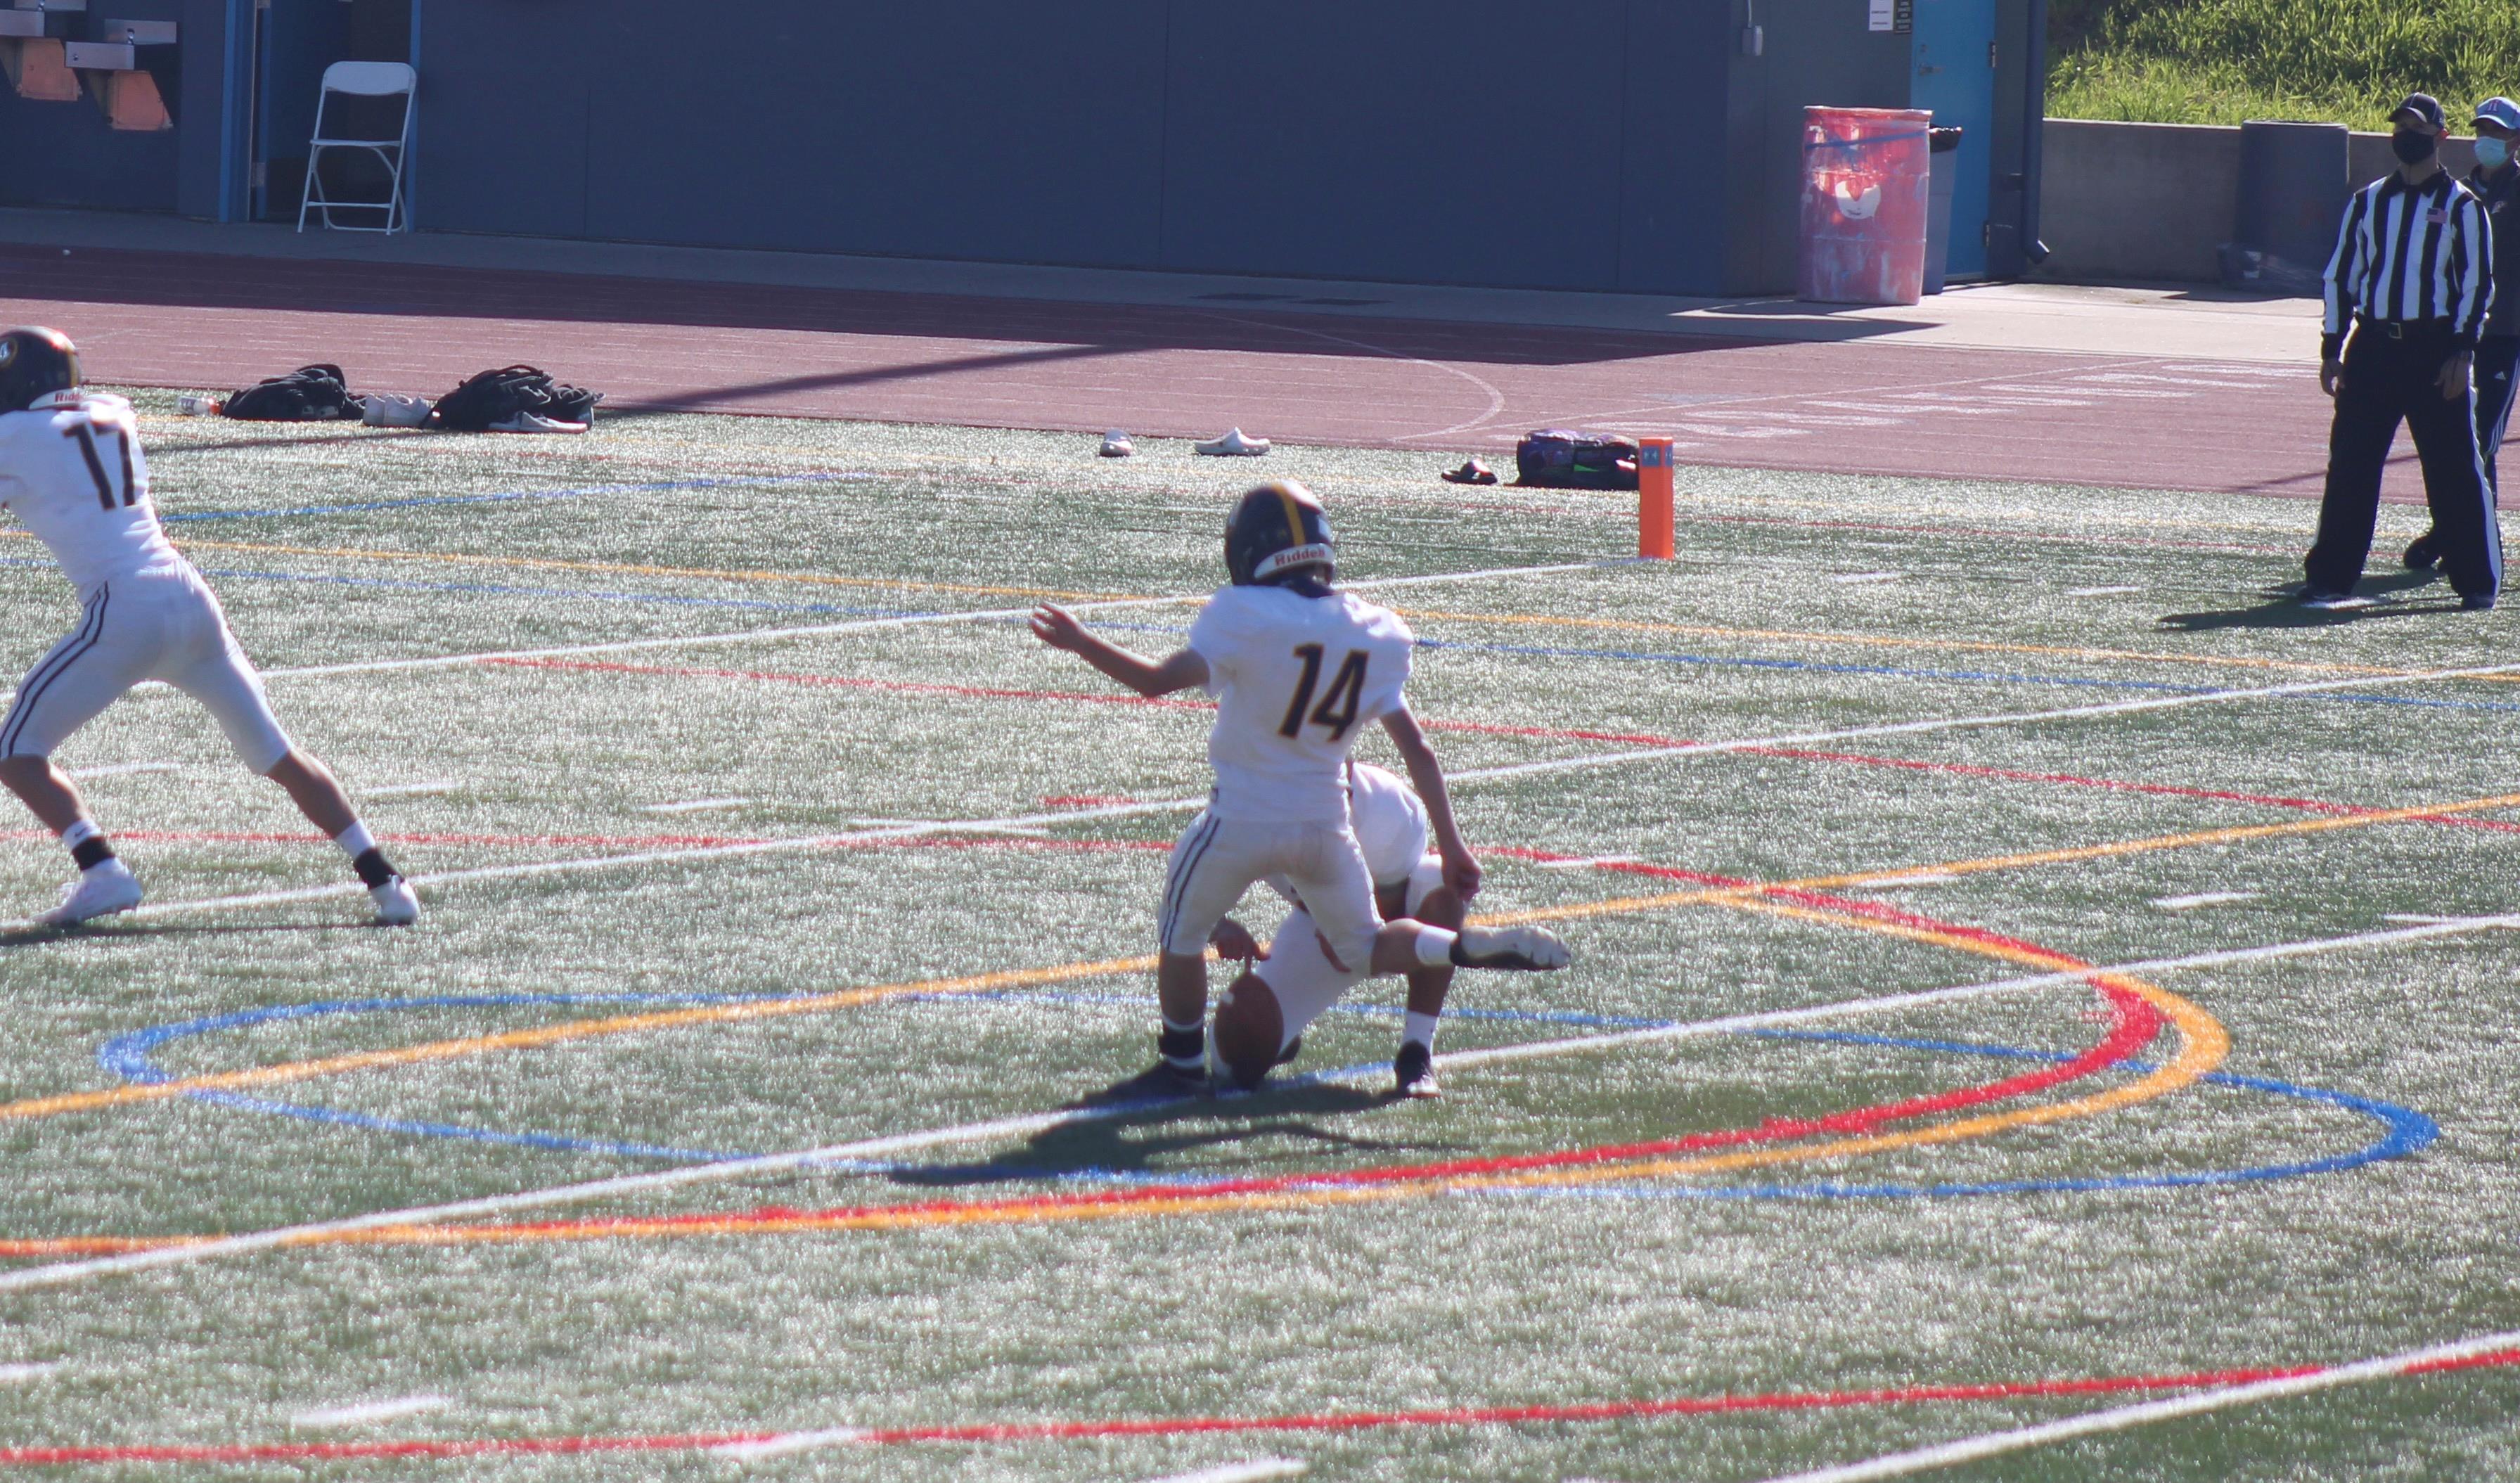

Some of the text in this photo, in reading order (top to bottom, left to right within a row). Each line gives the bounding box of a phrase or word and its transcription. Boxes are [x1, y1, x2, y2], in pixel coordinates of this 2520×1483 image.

[62, 422, 135, 510] 17
[1275, 548, 1325, 566] Riddell
[1276, 642, 1370, 743] 14
